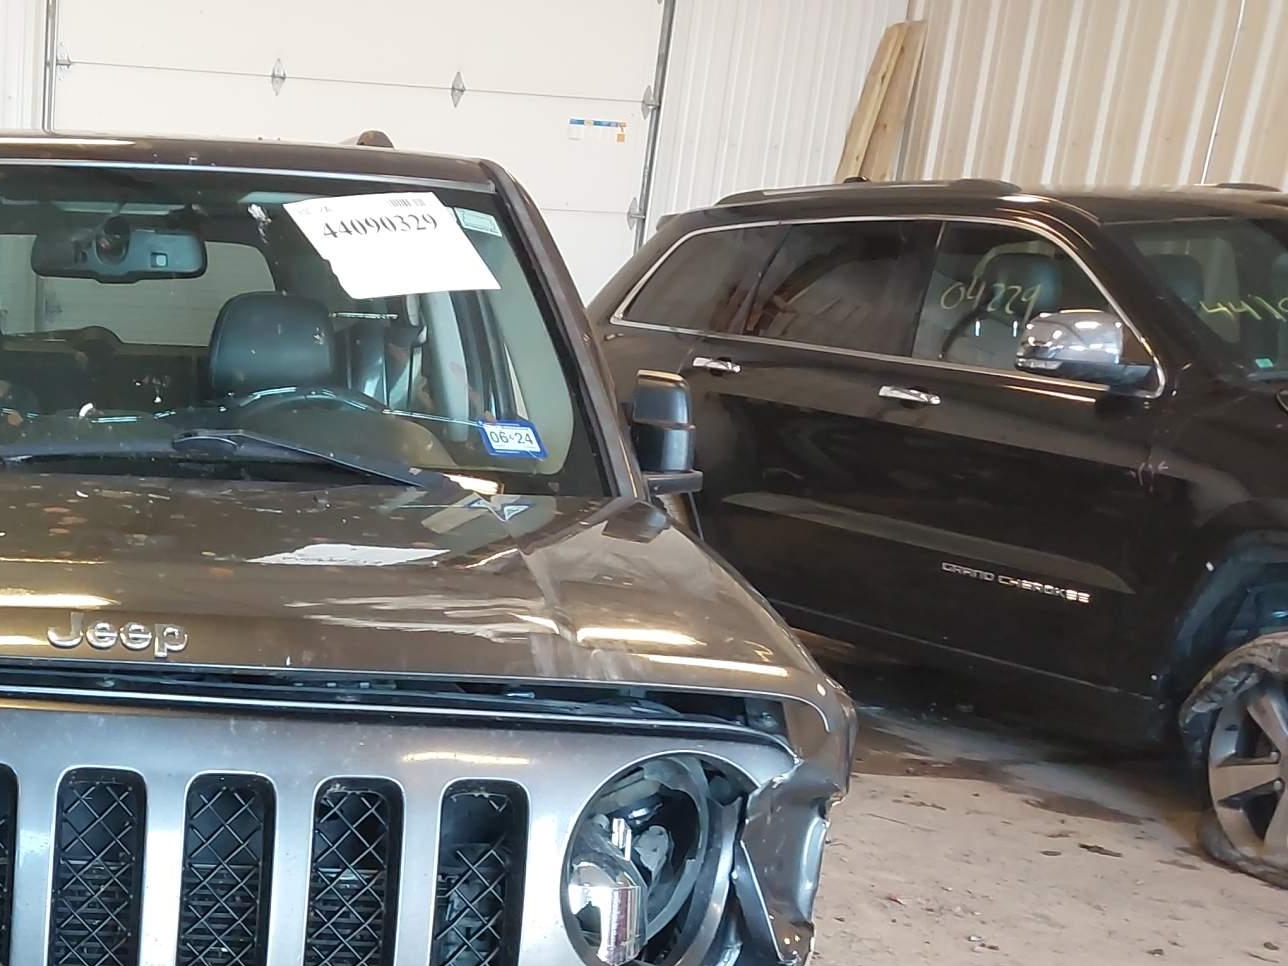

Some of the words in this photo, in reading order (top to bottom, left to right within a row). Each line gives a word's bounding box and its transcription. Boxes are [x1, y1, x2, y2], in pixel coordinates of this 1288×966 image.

[323, 214, 438, 238] 44090329
[941, 562, 995, 581] GRAND
[998, 575, 1090, 603] CHEROKEE
[47, 611, 188, 657] Jeep
